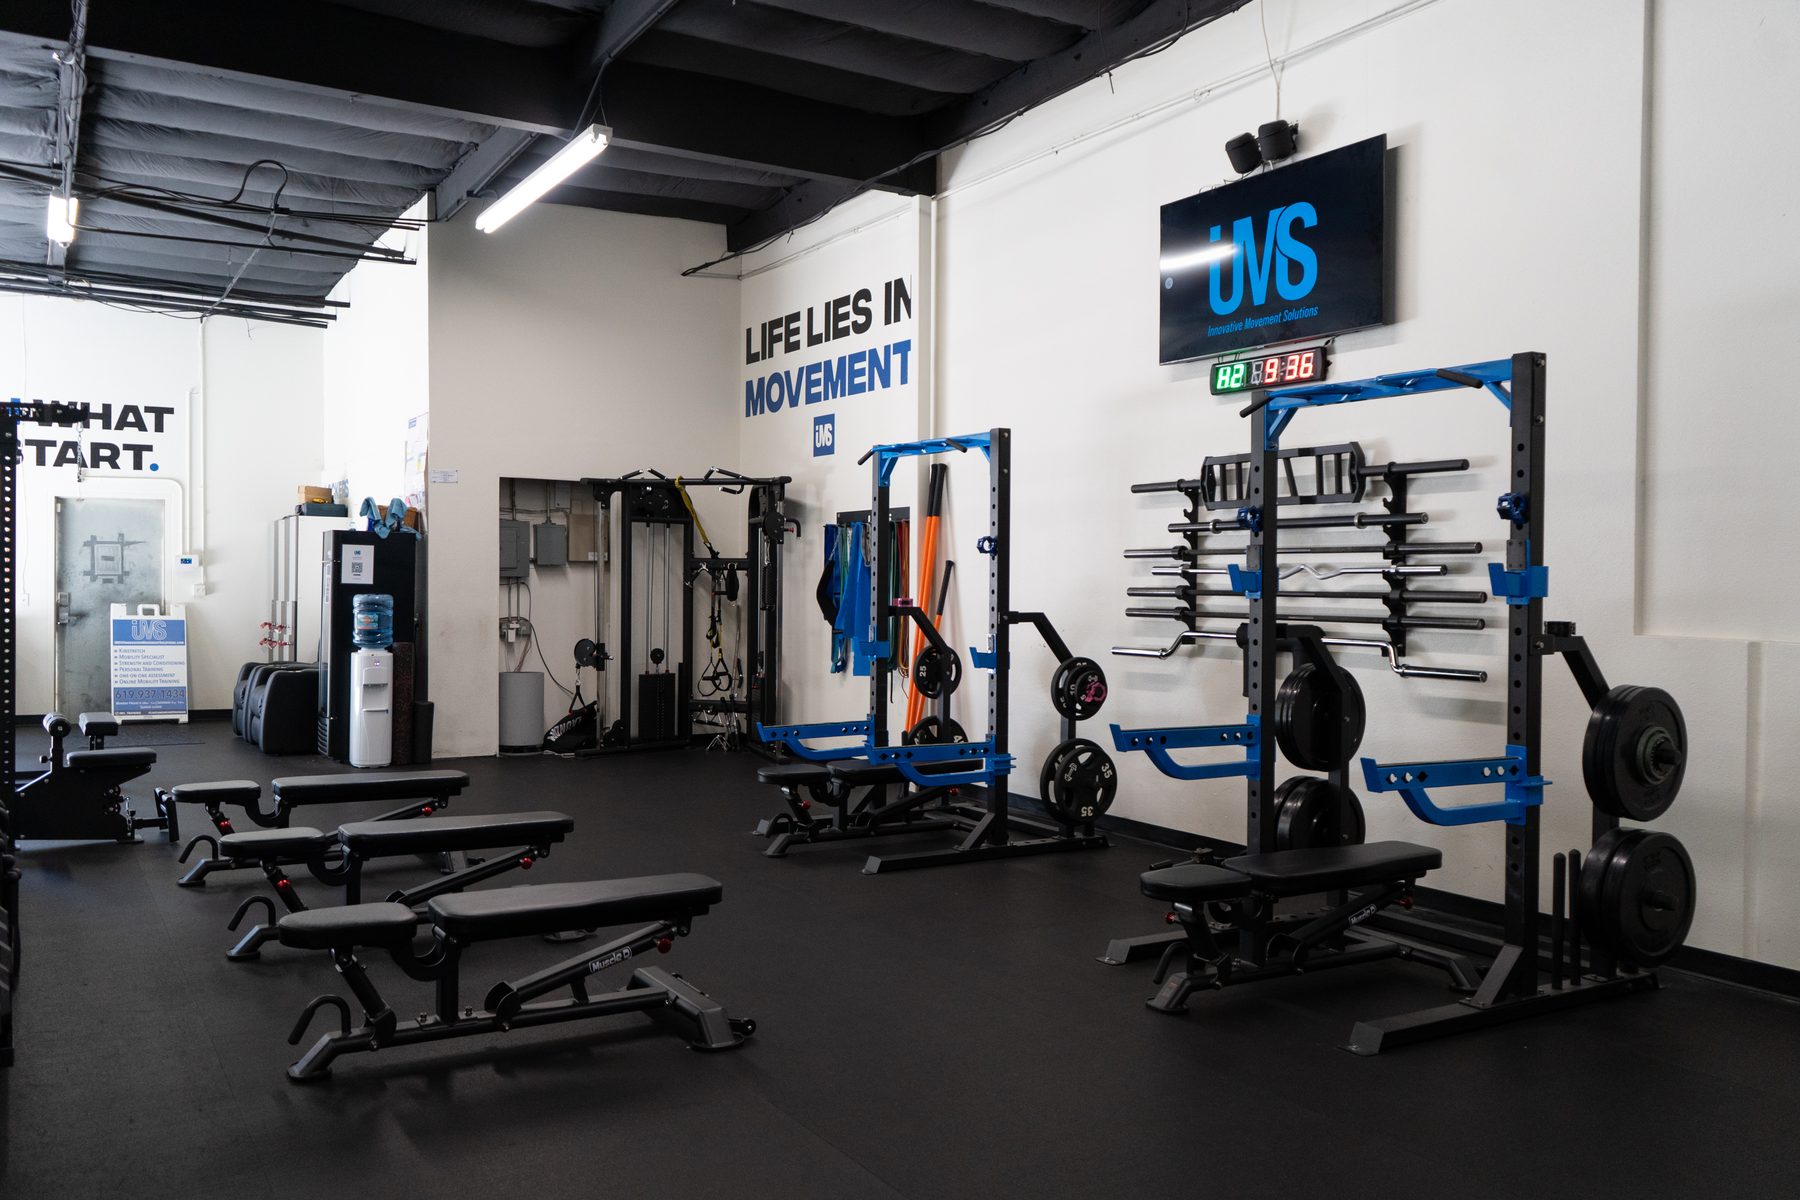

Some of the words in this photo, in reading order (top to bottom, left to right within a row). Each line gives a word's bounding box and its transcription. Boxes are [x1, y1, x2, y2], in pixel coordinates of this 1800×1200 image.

[746, 311, 801, 365] LIFE
[807, 288, 872, 347] LIES
[884, 276, 912, 326] IN
[1208, 320, 1244, 337] Innovative
[1244, 312, 1282, 329] Movement
[1282, 306, 1319, 322] Solutions
[745, 339, 912, 418] MOVEMENT
[24, 439, 160, 472] TART.
[115, 689, 185, 700] 619.937.1434
[1101, 762, 1113, 780] 35
[1081, 805, 1094, 817] 35
